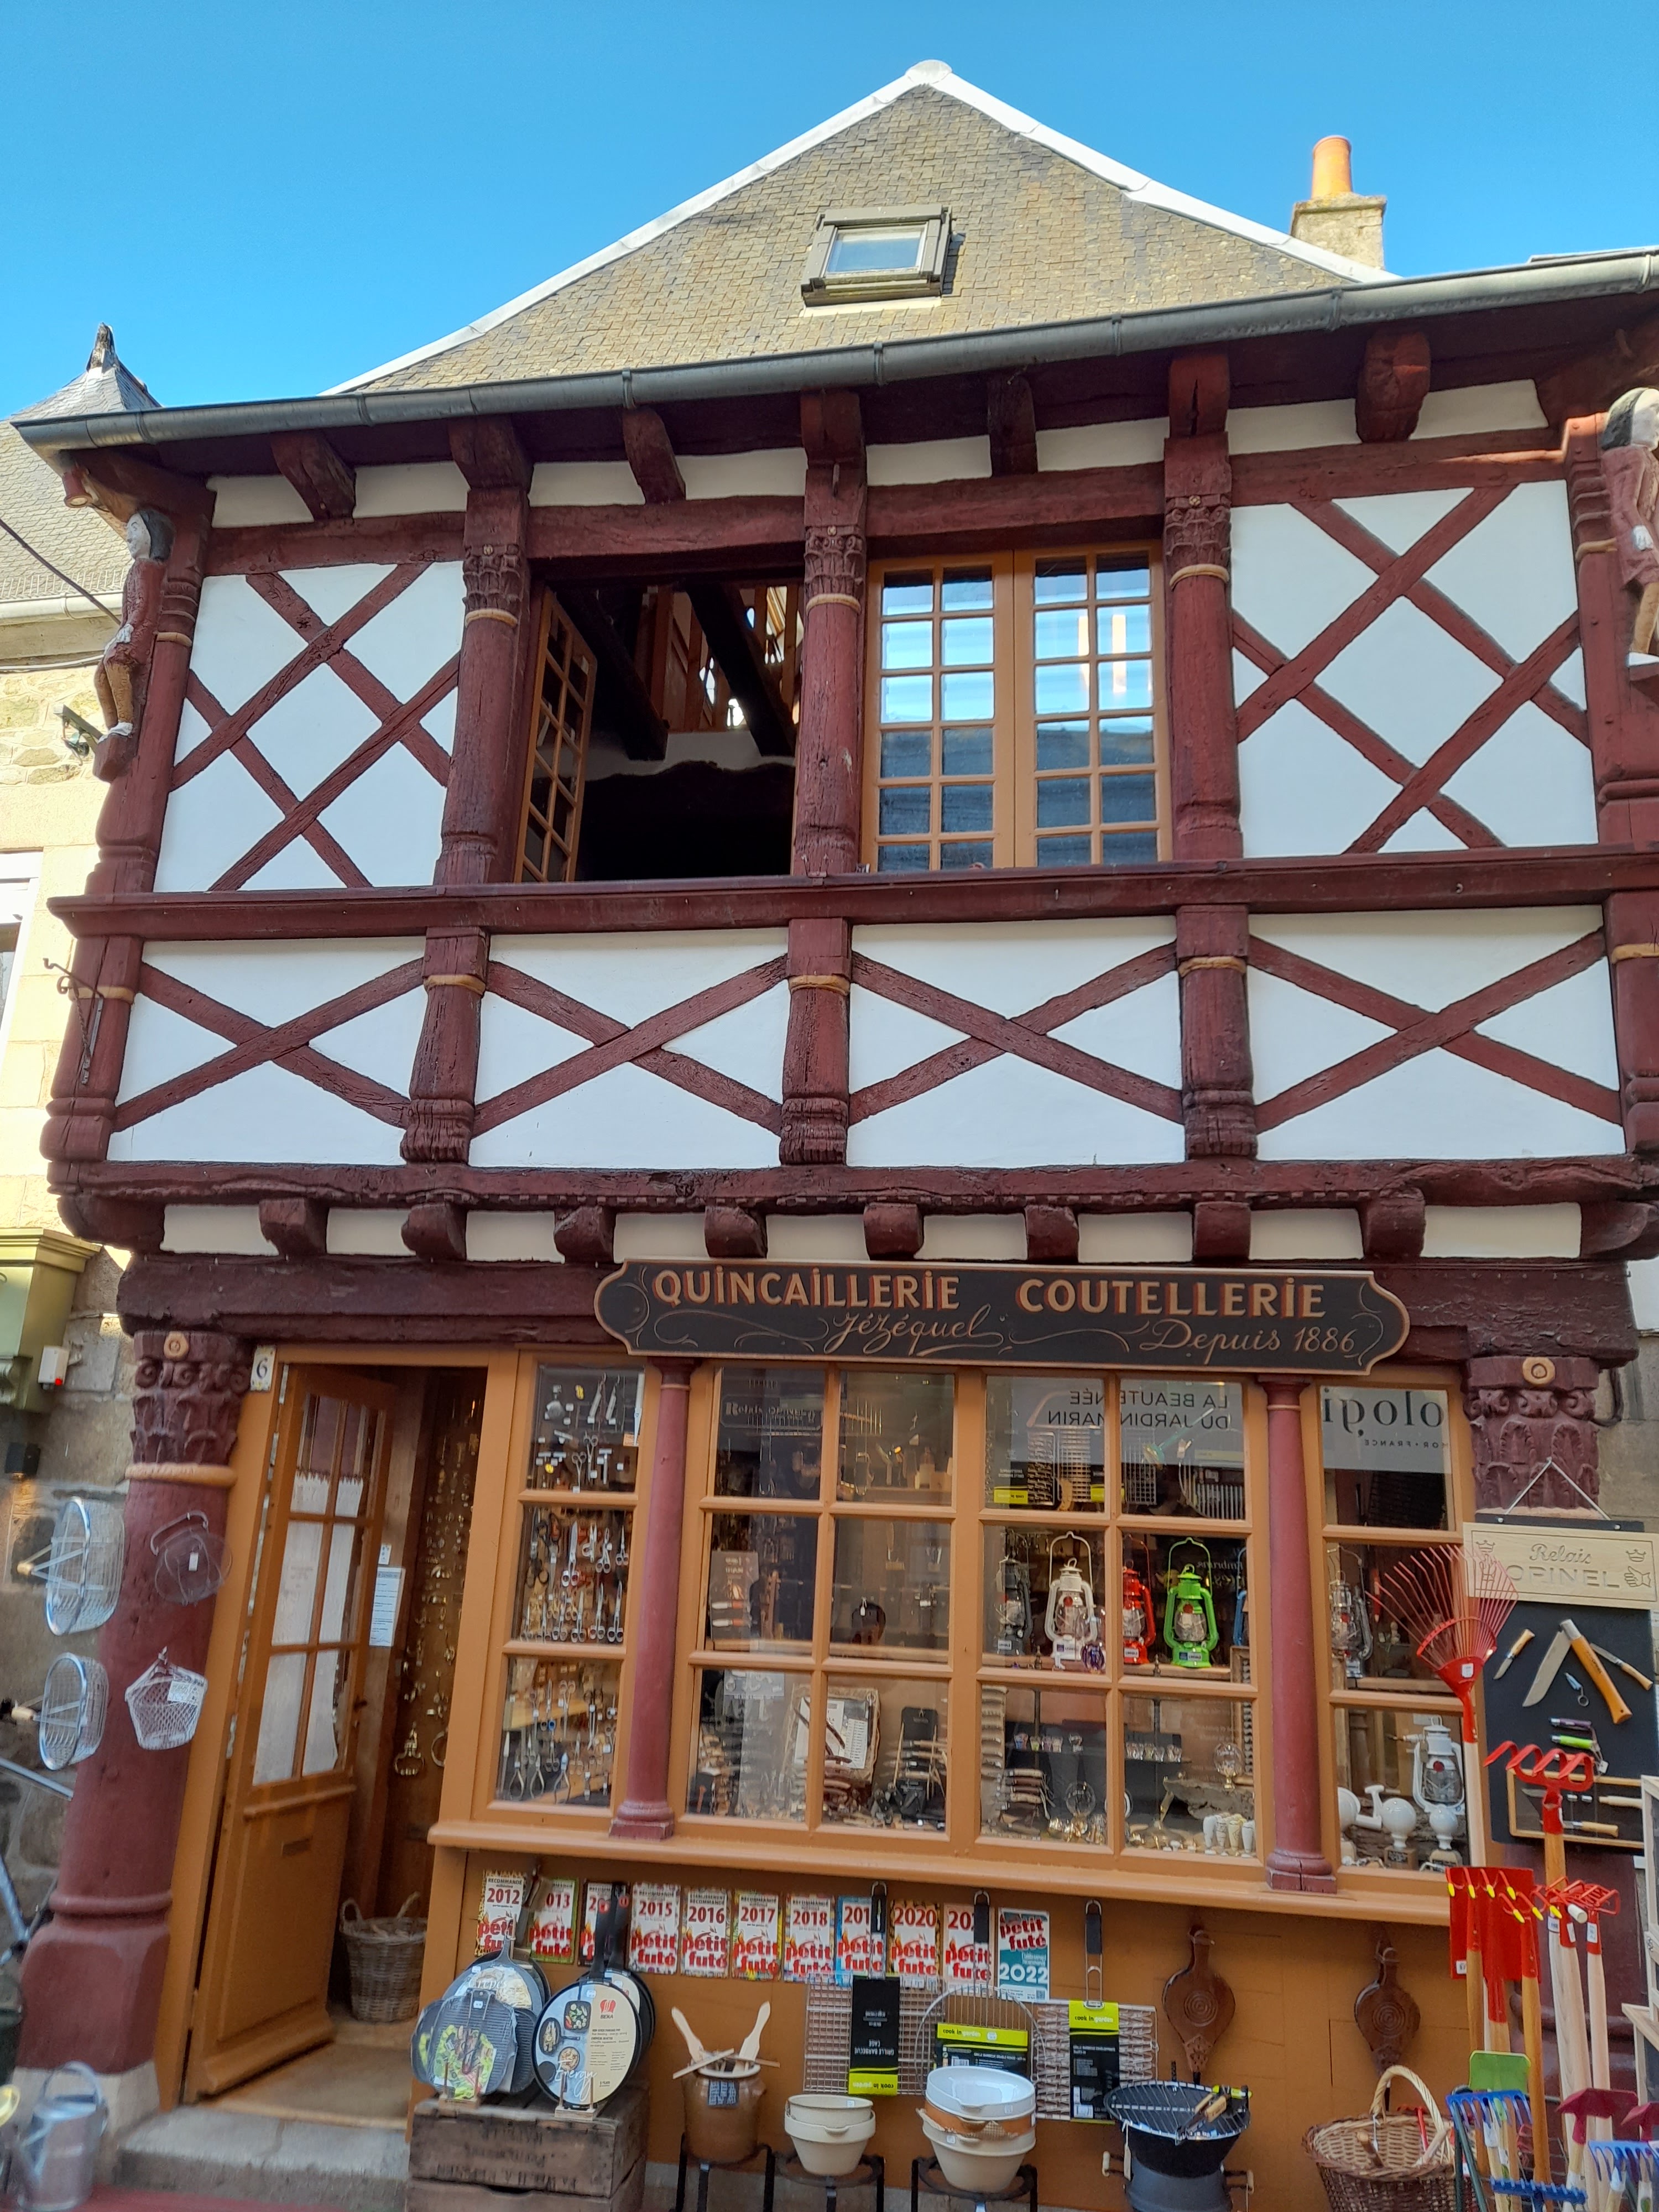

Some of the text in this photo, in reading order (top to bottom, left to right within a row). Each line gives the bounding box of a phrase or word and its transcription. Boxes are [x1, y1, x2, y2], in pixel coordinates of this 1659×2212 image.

[1015, 1276, 1327, 1318] COUTELLERIE
[1139, 1318, 1282, 1365] Depuis
[1293, 1326, 1355, 1353] 1886
[256, 1357, 268, 1379] 6
[1506, 1543, 1620, 1589] Relais OPINEL
[487, 1887, 520, 1905] 2012
[546, 1892, 571, 1908] 013
[638, 1900, 672, 1917] 2015
[688, 1906, 725, 1924] 2016
[740, 1906, 775, 1924] 2017
[792, 1909, 828, 1927] 2018
[844, 1906, 870, 1925] 201
[894, 1907, 937, 1928] 2020
[478, 1919, 513, 1938] peti
[948, 1910, 974, 1932] 20
[999, 1916, 1044, 1939] petit
[529, 1923, 573, 1942] petit
[630, 1933, 676, 1952] petit
[682, 1936, 727, 1955] petit
[733, 1940, 780, 1960] petit
[837, 1939, 884, 1957] petit
[891, 1943, 936, 1960] petit
[786, 1943, 832, 1962] petit
[945, 1947, 992, 1965] petit
[999, 1963, 1048, 1984] 2022
[554, 2059, 598, 2101] Energy
